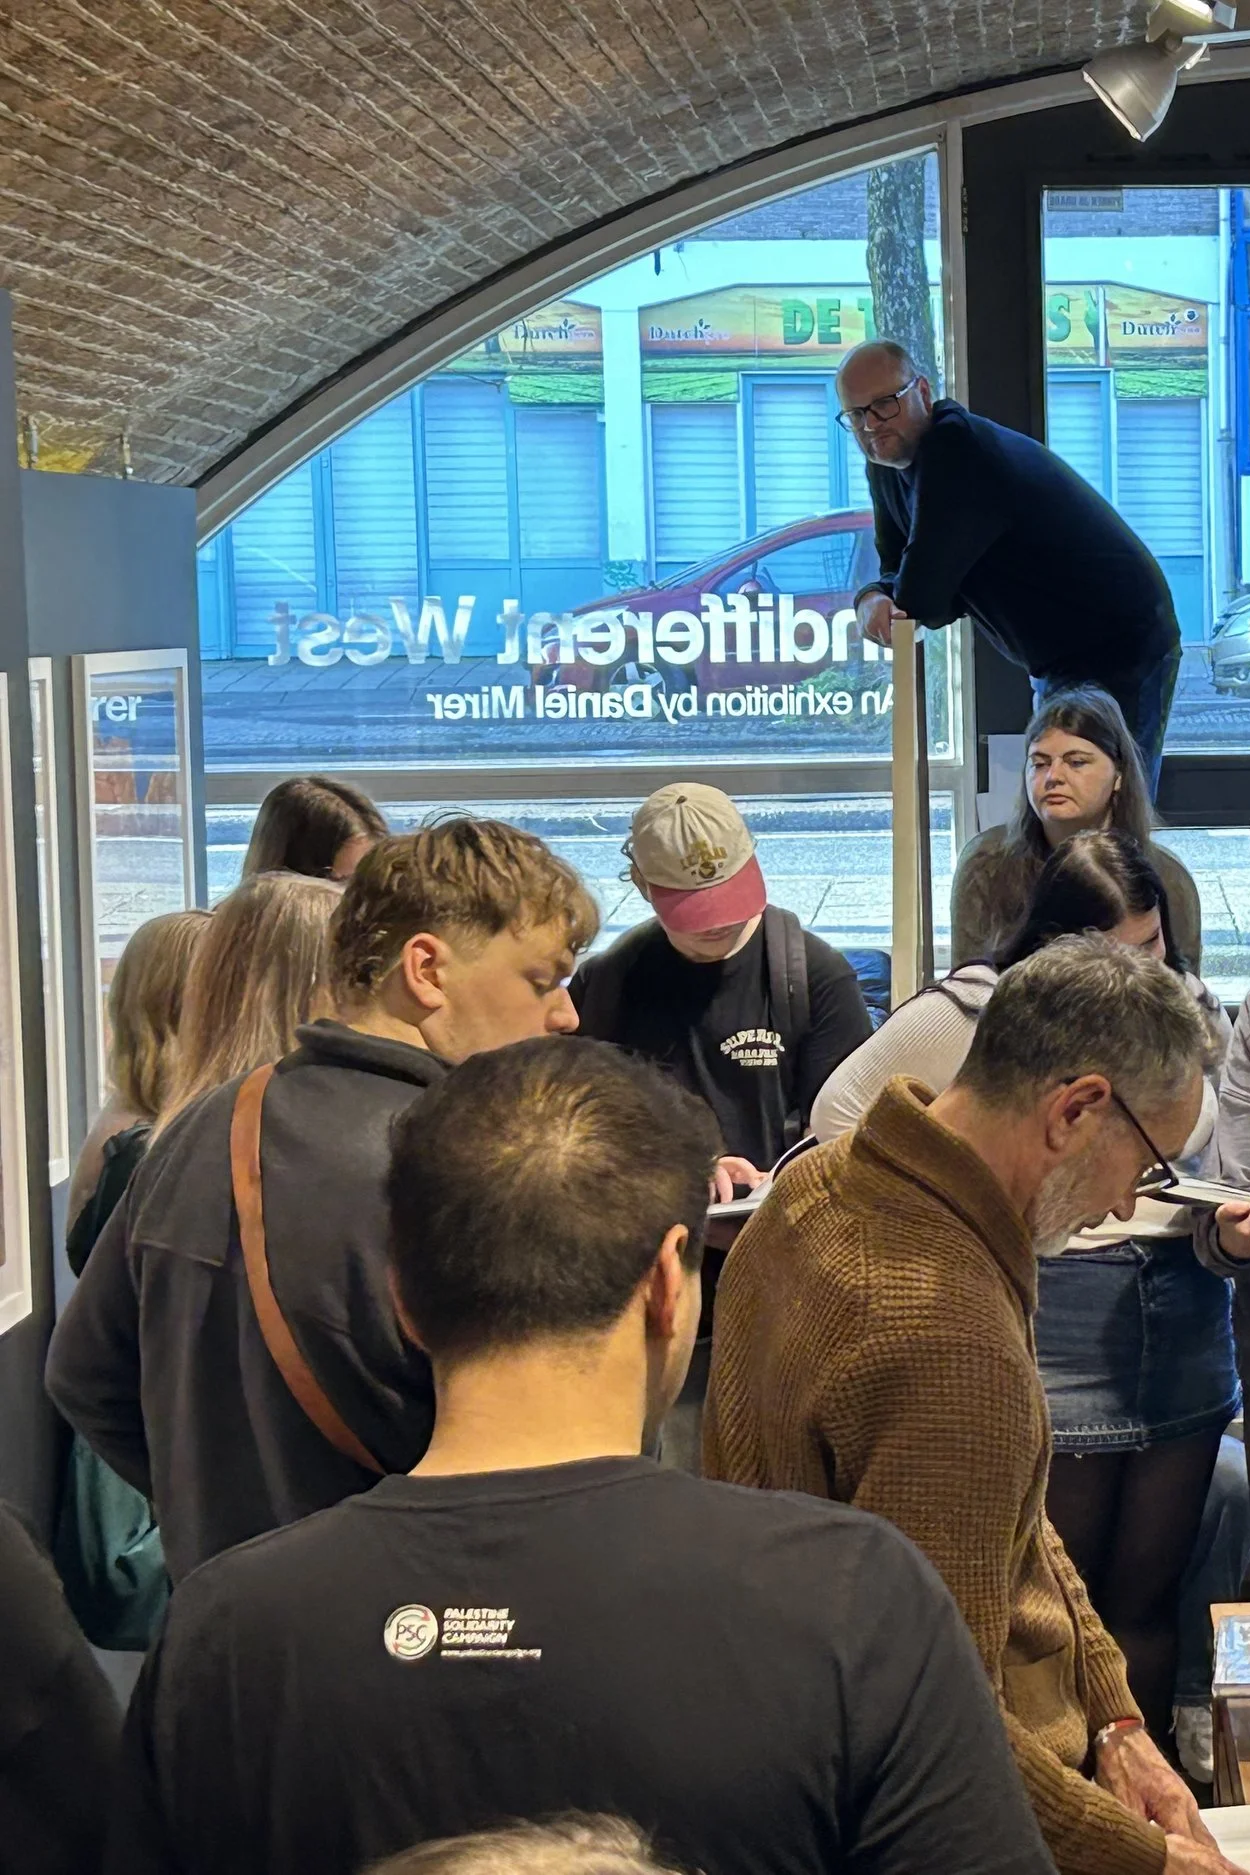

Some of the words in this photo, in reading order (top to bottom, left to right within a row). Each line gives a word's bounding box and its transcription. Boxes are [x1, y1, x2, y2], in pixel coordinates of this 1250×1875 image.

[782, 298, 842, 345] DE
[443, 1607, 510, 1619] PALESTINE
[443, 1619, 516, 1632] SOLIDARITY
[395, 1623, 429, 1643] PSC
[441, 1632, 508, 1645] CAMPAIGN
